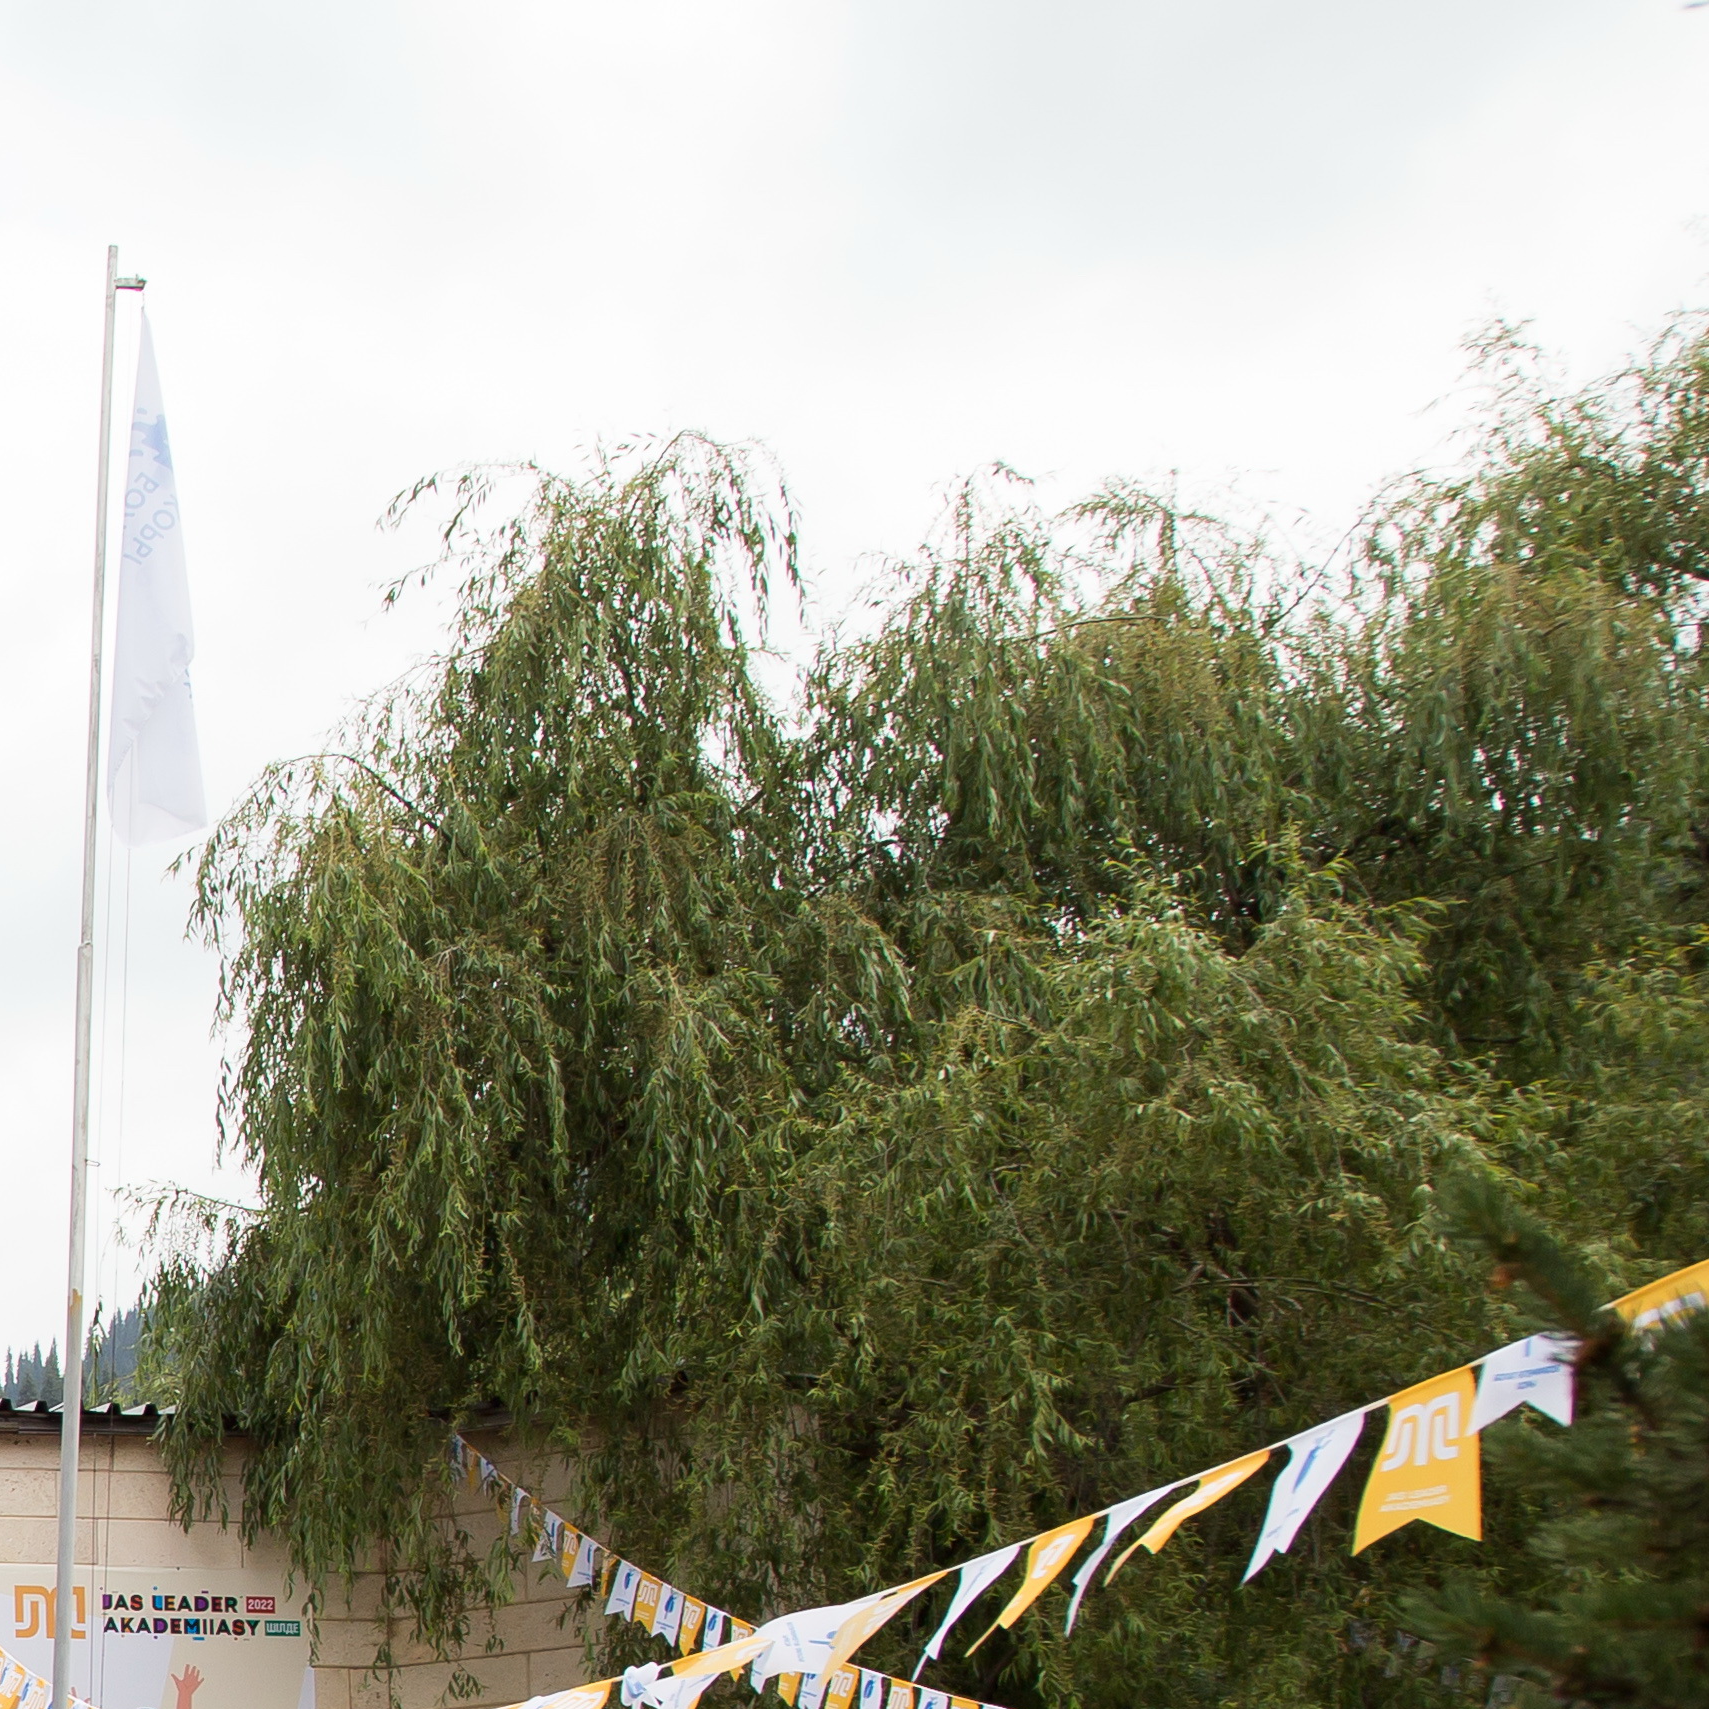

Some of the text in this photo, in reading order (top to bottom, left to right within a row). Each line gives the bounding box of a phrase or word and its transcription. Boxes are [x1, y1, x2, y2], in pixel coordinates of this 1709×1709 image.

[101, 1594, 274, 1613] JAS LEADER 2022
[103, 1616, 261, 1636] AKADEMIIASY
